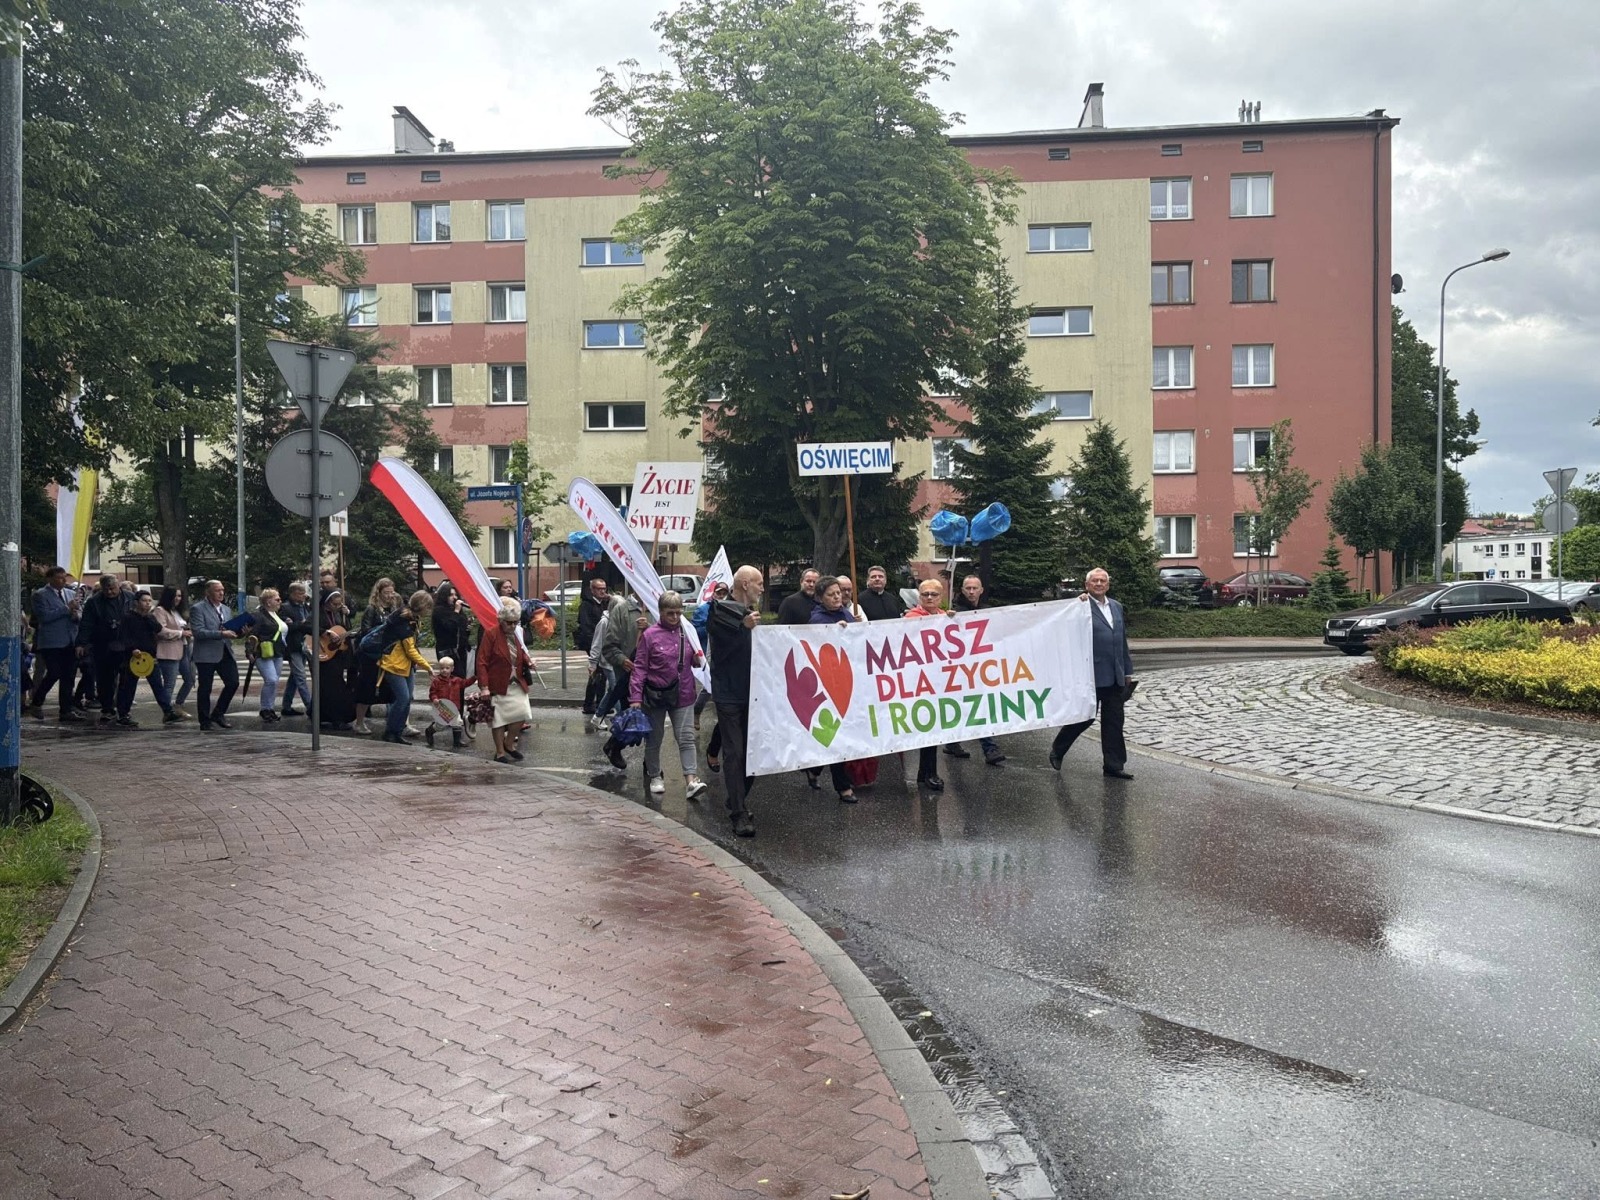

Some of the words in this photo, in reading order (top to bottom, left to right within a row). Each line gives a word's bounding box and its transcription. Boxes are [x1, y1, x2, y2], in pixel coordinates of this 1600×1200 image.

[800, 444, 890, 473] OŚWIĘCIM
[629, 508, 691, 535] ŚWIĘTE
[654, 500, 671, 508] JEST
[866, 619, 994, 675] MARSZ
[876, 668, 936, 702] DLA
[942, 656, 1035, 693] ŻYCIA
[868, 704, 879, 737] I
[889, 687, 1052, 735] RODZINY
